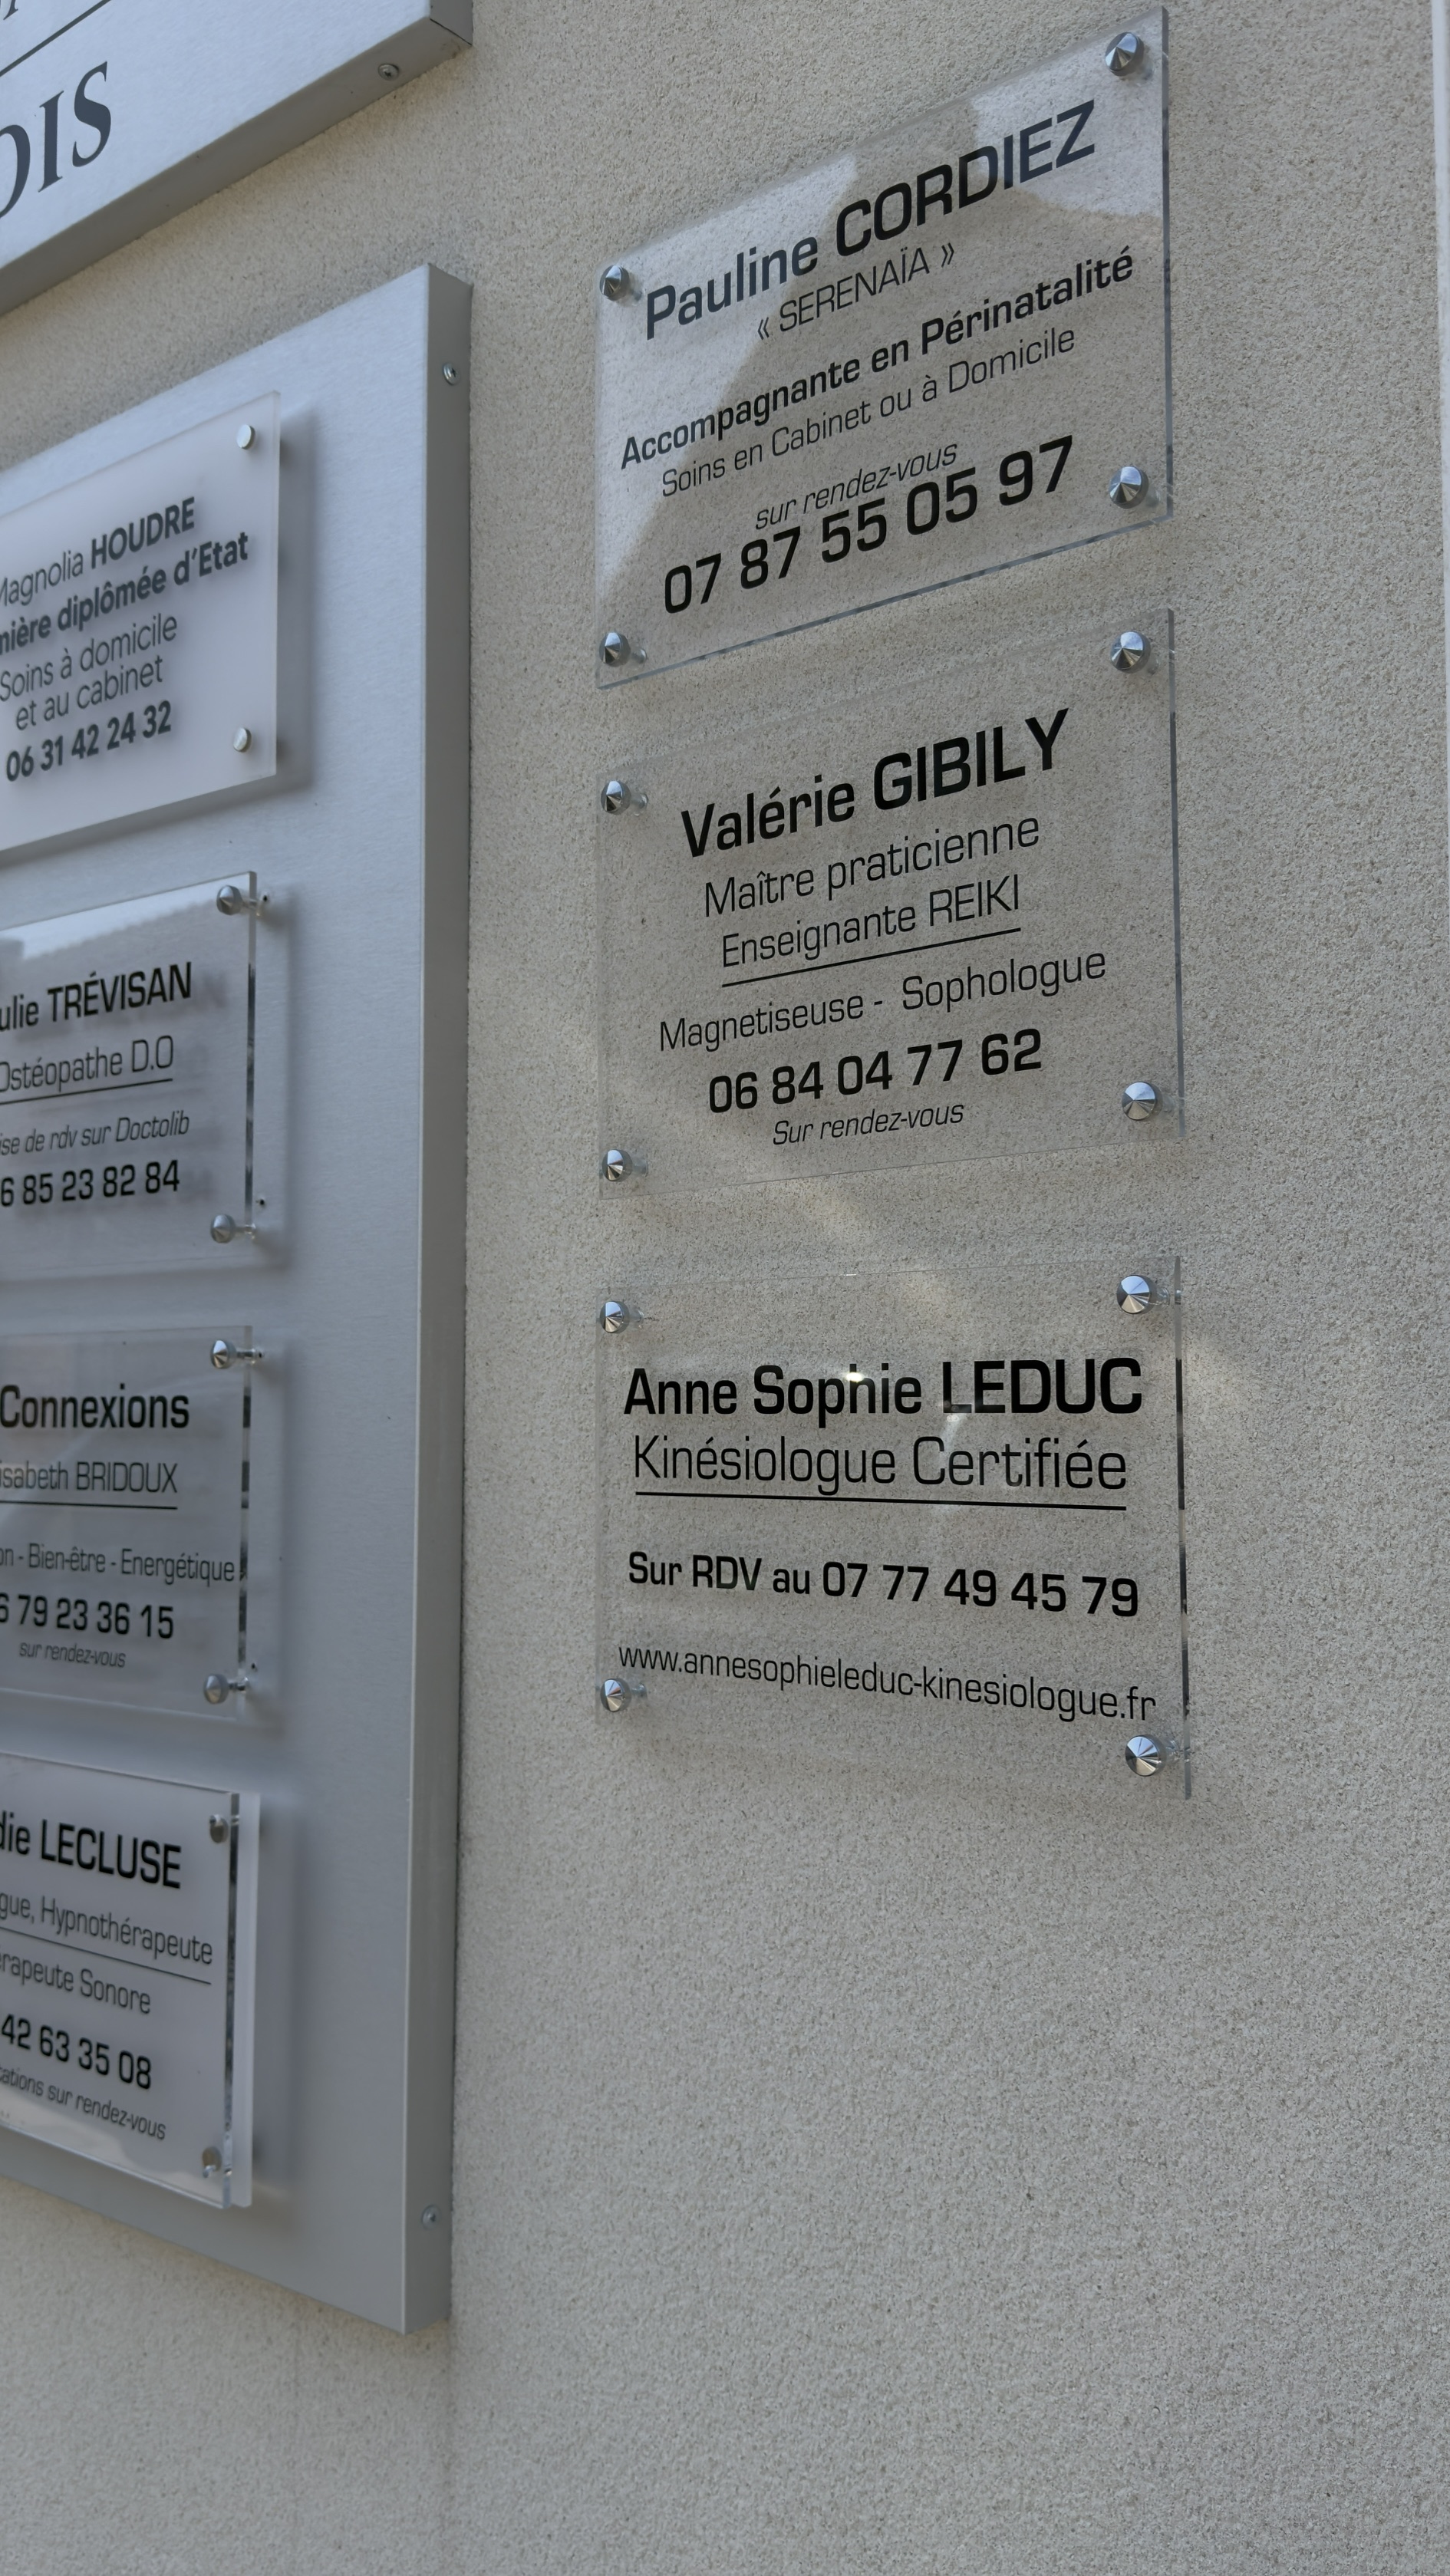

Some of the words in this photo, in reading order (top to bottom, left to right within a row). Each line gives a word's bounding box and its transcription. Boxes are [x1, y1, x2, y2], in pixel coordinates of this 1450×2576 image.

[647, 236, 818, 340] Pauline
[835, 99, 1095, 257] CORDIEZ
[779, 245, 930, 332] SERENAÏA
[621, 357, 860, 469] Accompagnante
[871, 338, 909, 372] en
[921, 245, 1133, 355] Périnatalité
[662, 457, 726, 497] Soins
[734, 443, 763, 472] en
[771, 400, 872, 457] Cabinet
[880, 390, 911, 417] ou
[922, 374, 938, 402] à
[950, 325, 1076, 394] Domicile
[756, 499, 796, 529] sur
[802, 443, 957, 516] rendez-vous
[91, 496, 196, 569] HOUDRE
[664, 553, 722, 614] 07
[740, 526, 801, 589] 87
[821, 497, 887, 563] 55
[905, 466, 977, 535] 05
[998, 435, 1073, 506] 97
[58, 565, 166, 632] diplômée
[0, 664, 53, 701] Soins
[60, 647, 72, 680] à
[80, 614, 177, 671] domicile
[16, 700, 36, 730] et
[44, 692, 69, 721] au
[77, 656, 163, 709] cabinet
[6, 746, 35, 782] 06
[40, 735, 64, 771] 31
[71, 723, 99, 759] 42
[107, 711, 136, 749] 24
[143, 700, 171, 739] 32
[681, 775, 854, 858] Valérie
[874, 707, 1069, 810] GIBILY
[705, 868, 815, 917] Maître
[828, 818, 1040, 901] praticienne
[723, 905, 916, 967] Enseignante
[930, 874, 1020, 927] REIKI
[48, 961, 192, 1023] TRÉVISAN
[661, 995, 864, 1052] Magnetiseuse
[902, 952, 1106, 1012] Sophologue
[0, 1046, 122, 1092] Ostéopathe
[131, 1036, 173, 1073] D.O
[709, 1072, 757, 1112] 06
[772, 1061, 823, 1105] 84
[837, 1051, 892, 1095] 04
[907, 1039, 963, 1085] 77
[981, 1028, 1042, 1076] 62
[25, 1128, 44, 1152] de
[49, 1125, 77, 1150] rdv
[81, 1124, 110, 1146] sur
[115, 1110, 189, 1142] Doctolib
[773, 1119, 813, 1145] Sur
[821, 1103, 964, 1140] rendez-vous
[23, 1173, 53, 1204] 85
[62, 1169, 93, 1201] 23
[103, 1164, 135, 1197] 82
[145, 1159, 180, 1194] 84
[1, 1383, 189, 1428] Connexions
[624, 1368, 737, 1415] Anne
[753, 1363, 921, 1428] Sophie
[942, 1358, 1142, 1415] LEDUC
[76, 1461, 177, 1493] BRIDOUX
[634, 1435, 895, 1496] Kinésiologue
[913, 1436, 1127, 1491] Certifiée
[29, 1543, 105, 1573] Bien-être
[121, 1548, 234, 1587] Energétique
[628, 1551, 682, 1586] Sur
[692, 1554, 762, 1591] RDV
[772, 1566, 810, 1594] au
[822, 1561, 868, 1598] 07
[882, 1564, 929, 1603] 77
[944, 1568, 997, 1607] 49
[1010, 1572, 1066, 1612] 45
[1081, 1575, 1139, 1617] 79
[18, 1594, 48, 1626] 79
[56, 1598, 88, 1631] 23
[97, 1601, 130, 1635] 36
[140, 1605, 173, 1639] 15
[19, 1641, 41, 1659] sur
[44, 1642, 126, 1668] rendez-vous
[618, 1645, 1156, 1722] www.annesophieleduc-kinesiologue.fr
[41, 1819, 181, 1889] LECLUSE
[41, 1896, 212, 1965] Hypnothérapeute
[0, 1952, 74, 1992] rapeute
[80, 1968, 151, 2014] Sonore
[2, 2014, 31, 2050] 42
[40, 2024, 70, 2063] 63
[78, 2037, 110, 2076] 35
[118, 2050, 152, 2090] 08
[48, 2084, 73, 2105] sur
[77, 2094, 166, 2140] rendez-vous
